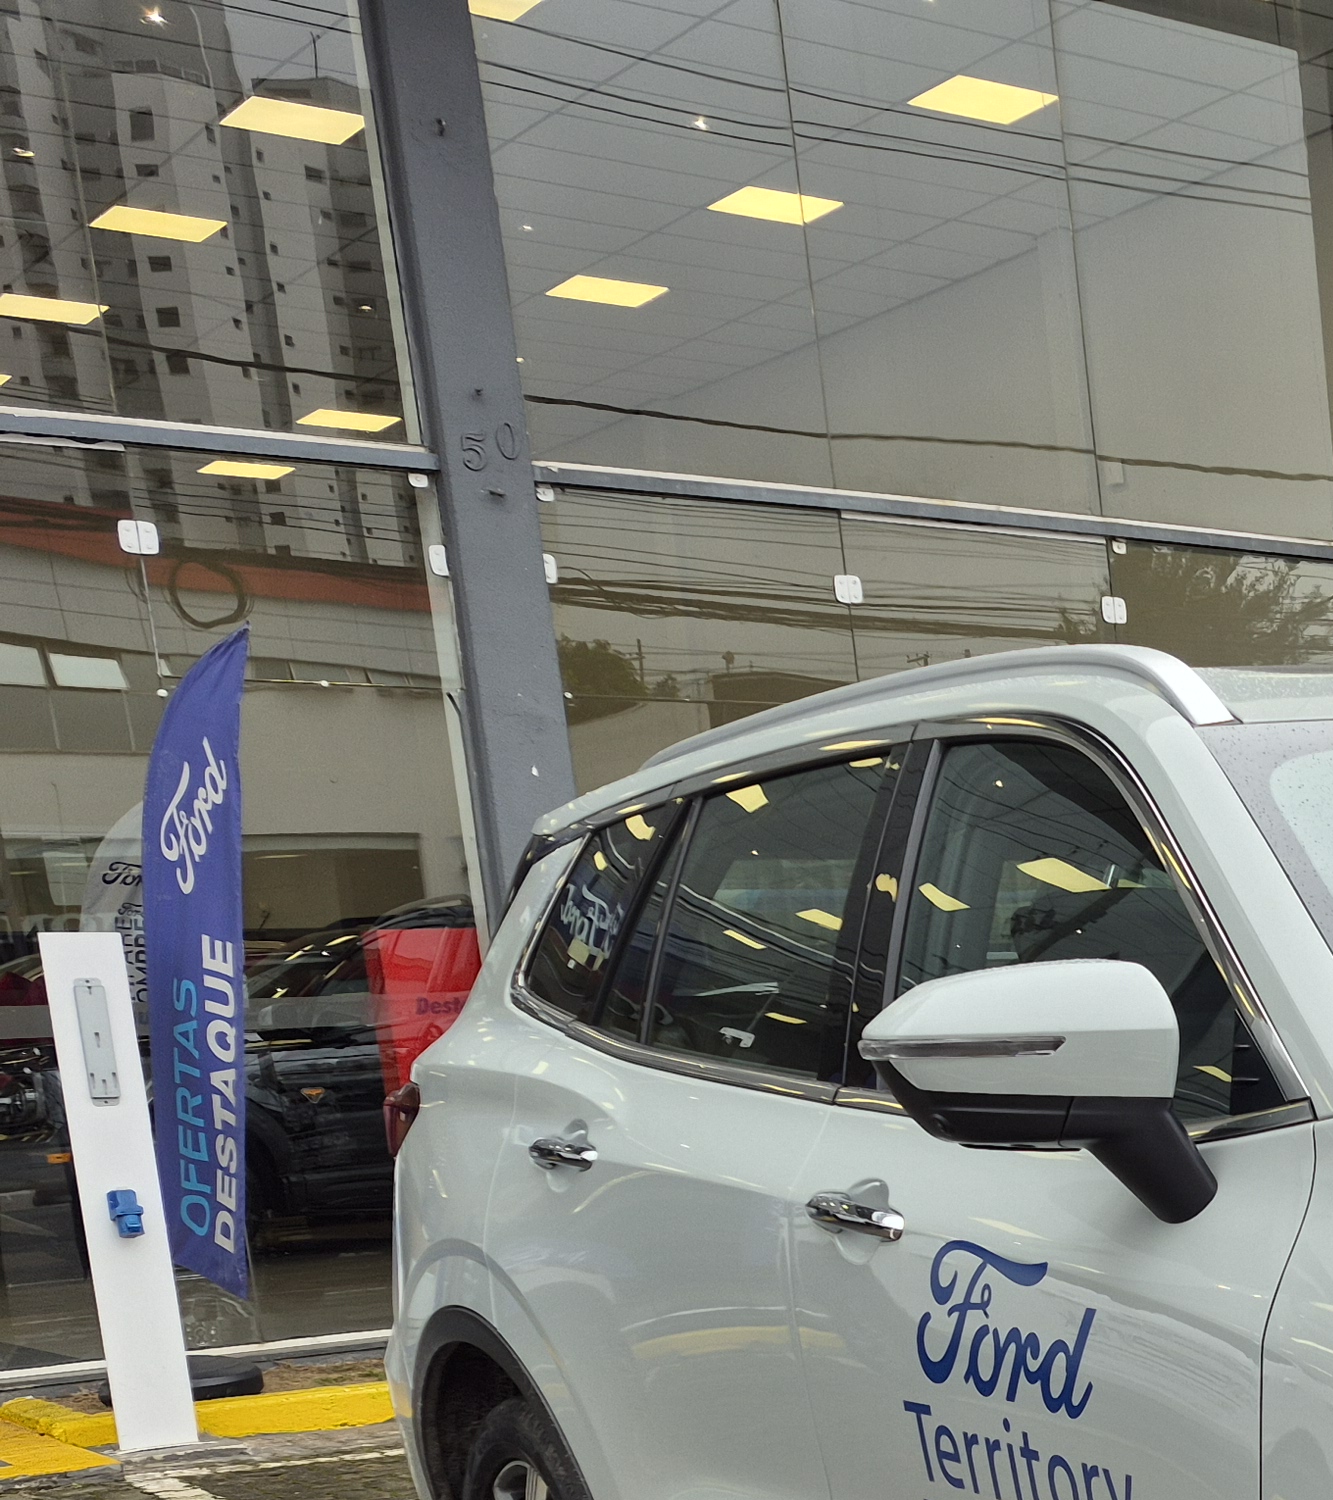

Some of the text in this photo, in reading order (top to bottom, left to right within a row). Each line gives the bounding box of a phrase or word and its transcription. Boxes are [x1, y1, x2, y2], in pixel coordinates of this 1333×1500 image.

[160, 737, 228, 895] Ford
[173, 977, 211, 1237] OFERTAS
[201, 933, 237, 1254] DESTAQUE
[916, 1239, 1097, 1420] Ford
